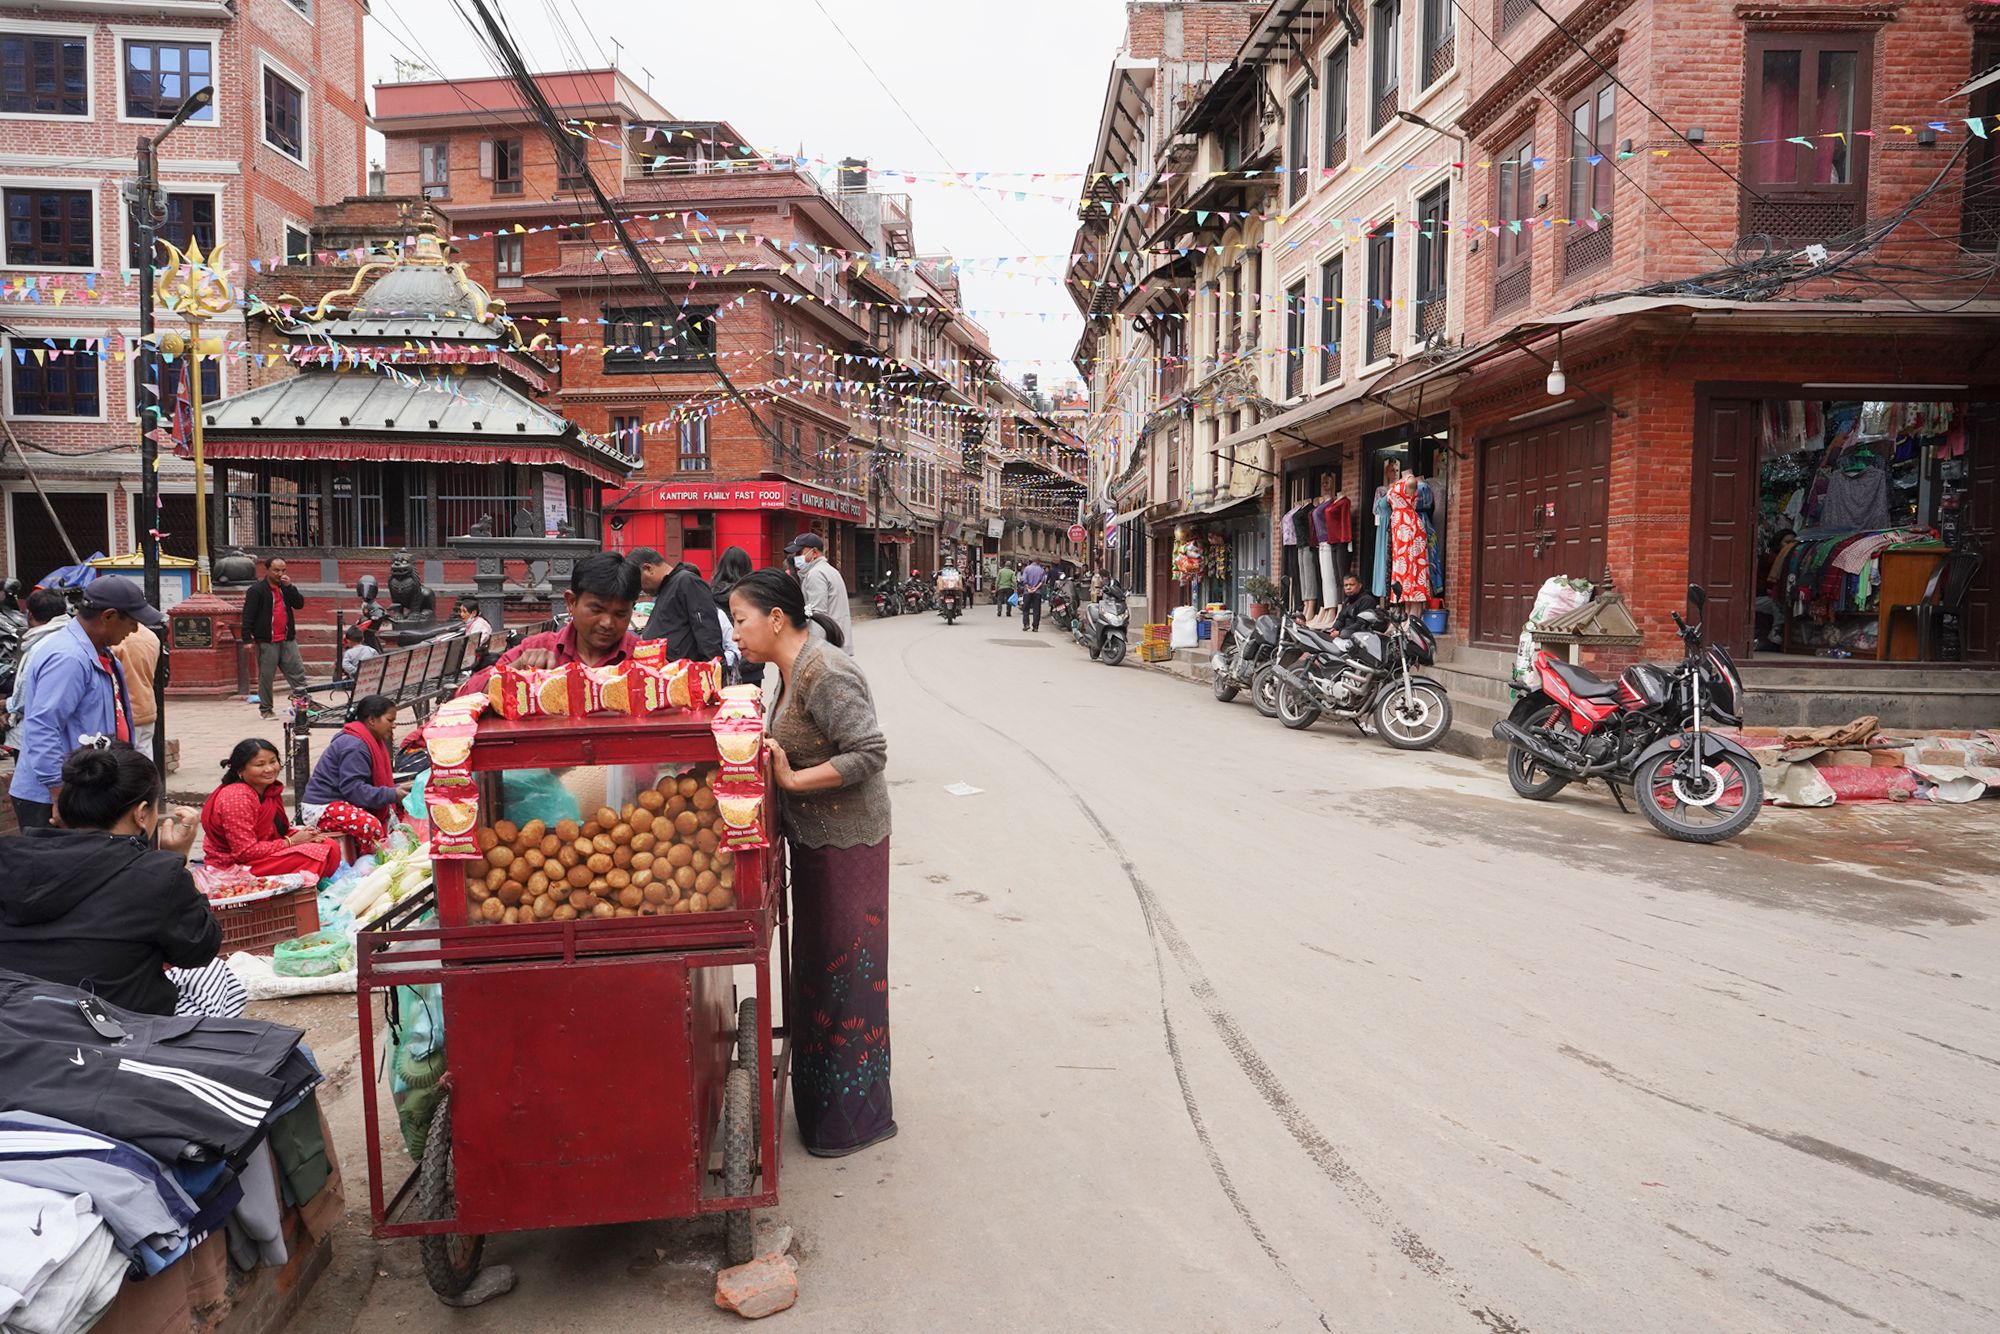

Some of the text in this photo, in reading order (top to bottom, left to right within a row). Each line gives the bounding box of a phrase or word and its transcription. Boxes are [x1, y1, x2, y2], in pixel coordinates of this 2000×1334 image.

[659, 491, 781, 501] KANTIPUR FAMILY FAST FOOD
[801, 493, 824, 509] KANTIPUR
[825, 498, 839, 512] FAMILY
[851, 505, 861, 516] FOOD
